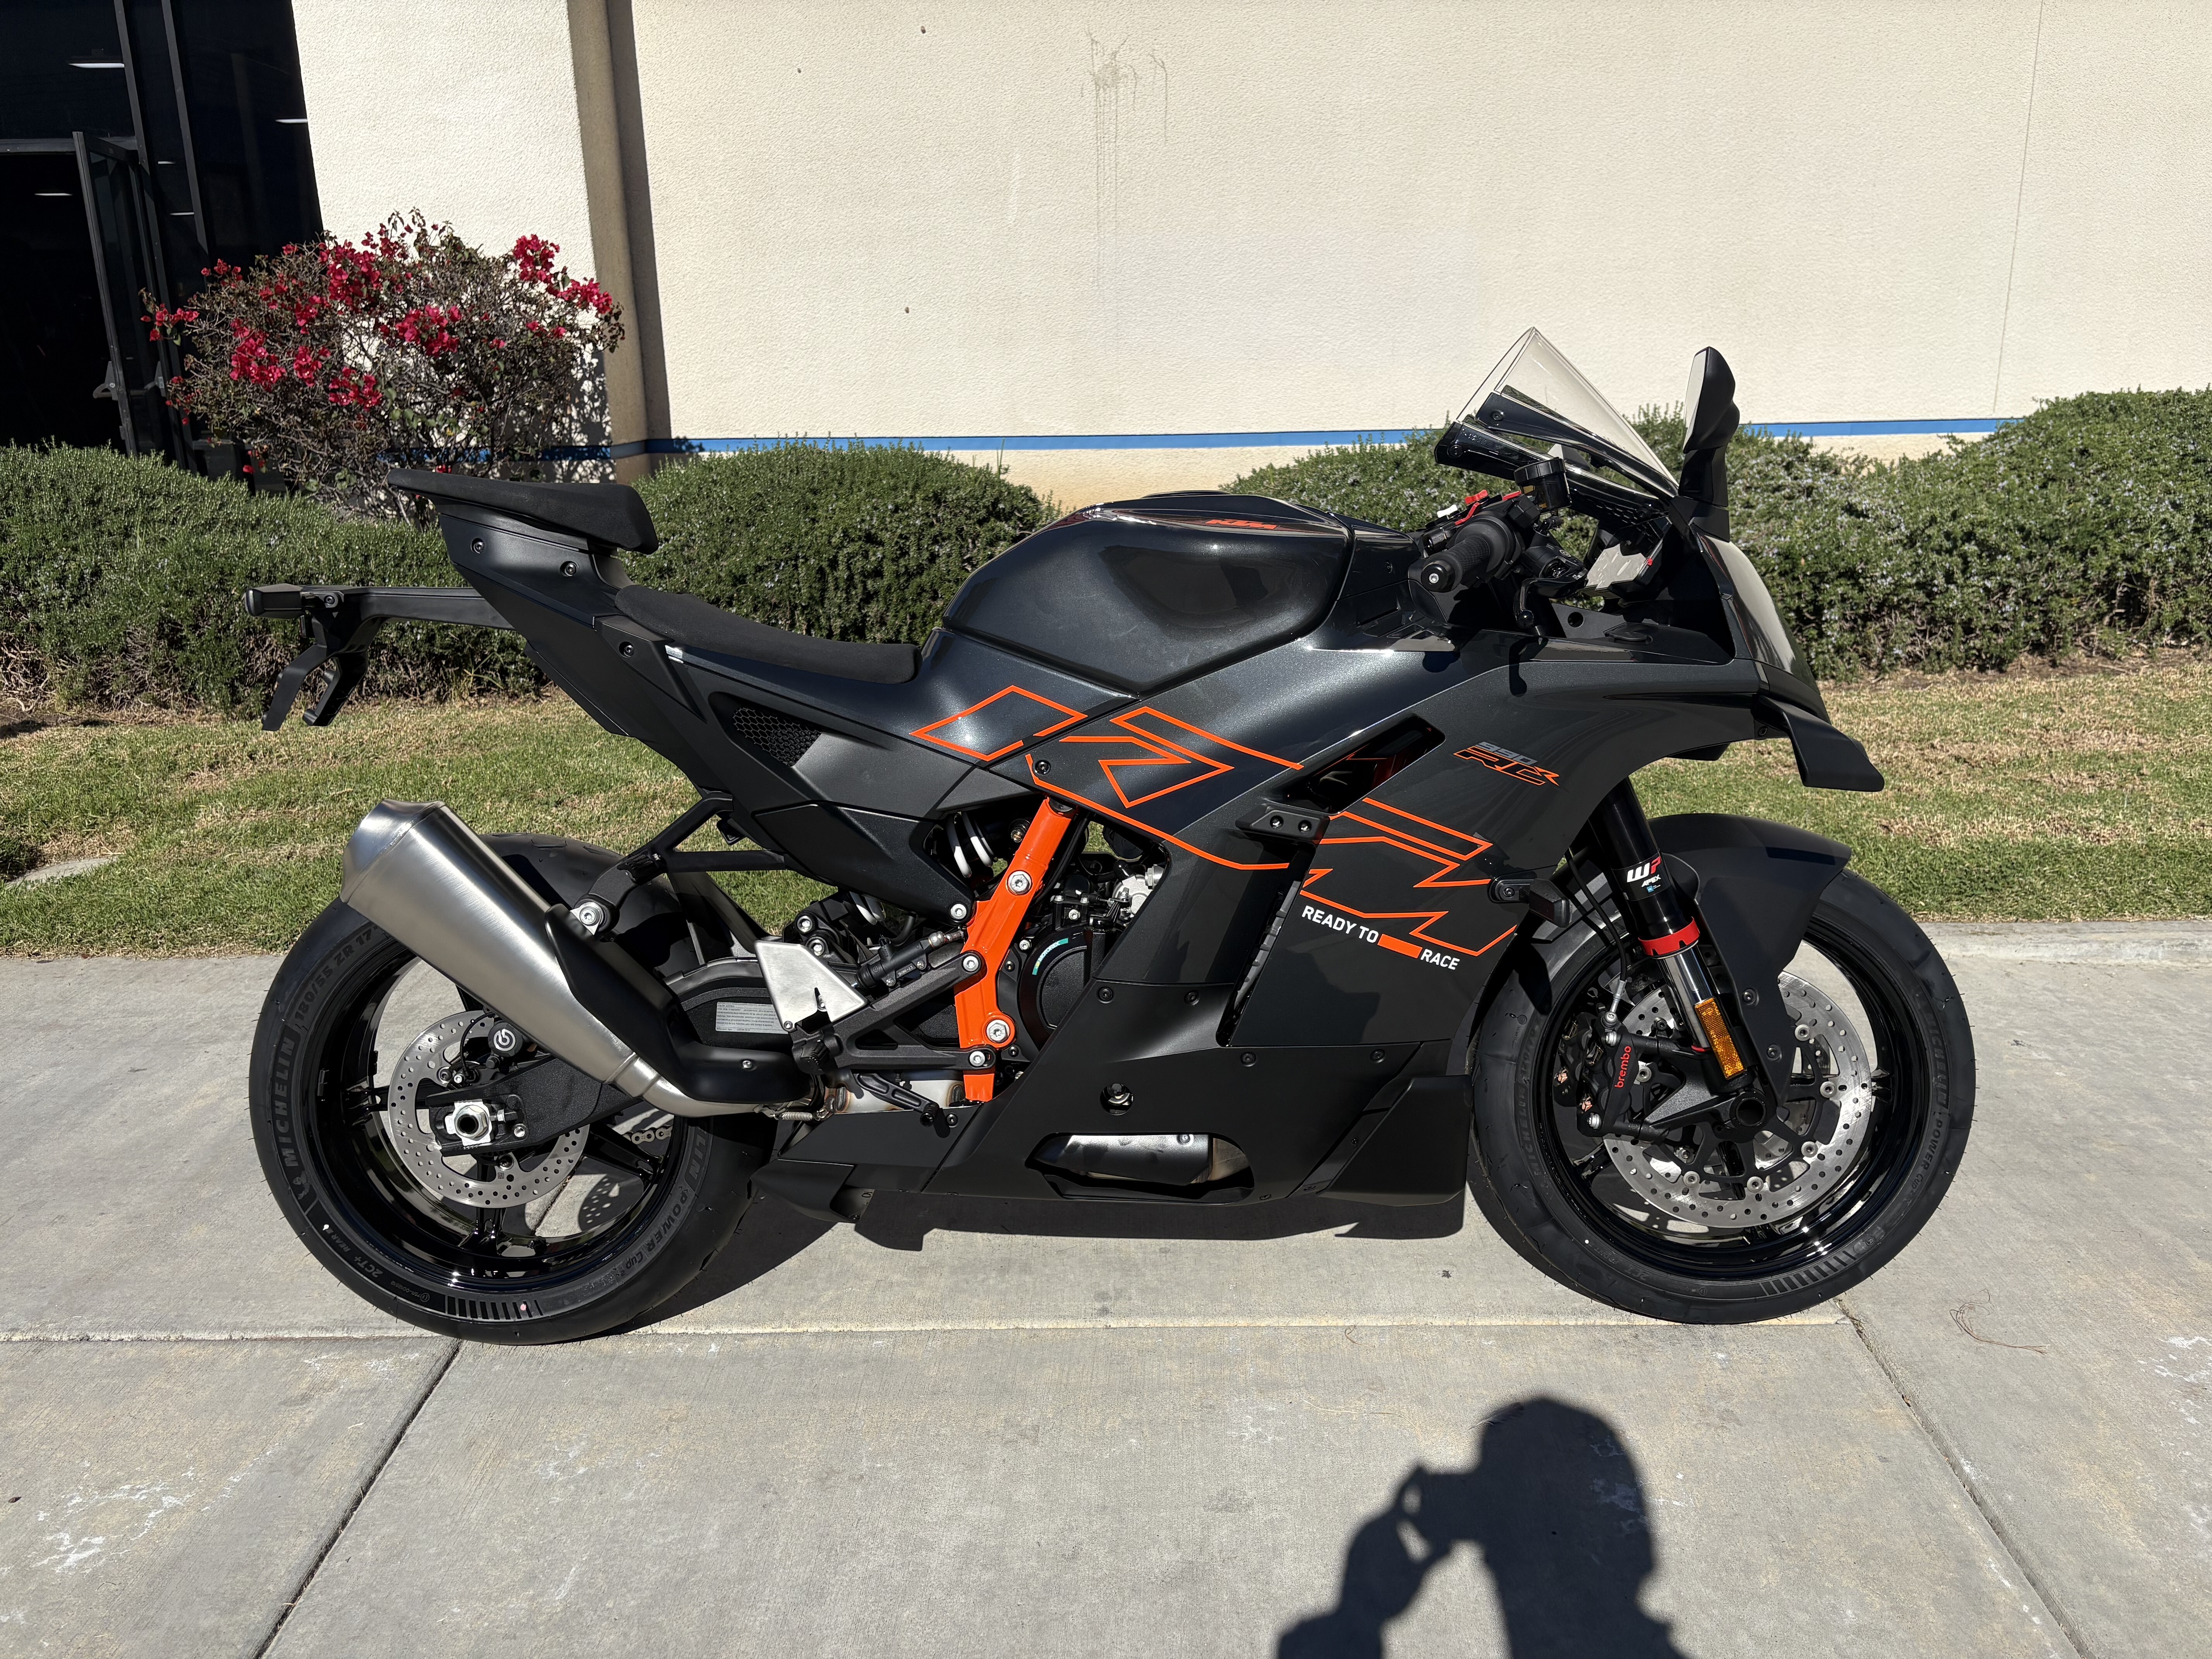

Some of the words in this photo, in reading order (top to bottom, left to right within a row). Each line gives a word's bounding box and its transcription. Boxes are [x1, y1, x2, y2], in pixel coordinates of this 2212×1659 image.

[1206, 519, 1277, 530] KTM
[1474, 741, 1538, 766] 990
[1627, 856, 1661, 883] WP
[1641, 874, 1661, 887] APEX
[1302, 905, 1357, 934] READY
[1359, 926, 1379, 943] TO
[1038, 941, 1061, 962] MOTOREX
[1420, 949, 1460, 970] RACE
[295, 965, 333, 1021] 180/55
[334, 944, 355, 967] ZR
[1614, 1046, 1632, 1088] brembo
[1924, 1013, 1948, 1105] MICHELIN
[275, 1037, 298, 1167] MICHELIN
[1518, 1086, 1542, 1177] MICHELIN
[1921, 1119, 1943, 1170] POWER
[1912, 1173, 1923, 1189] Cup
[646, 1191, 688, 1252] POWER
[331, 1234, 350, 1252] REAR
[354, 1256, 383, 1278] 2CT+
[625, 1251, 643, 1269] Cup
